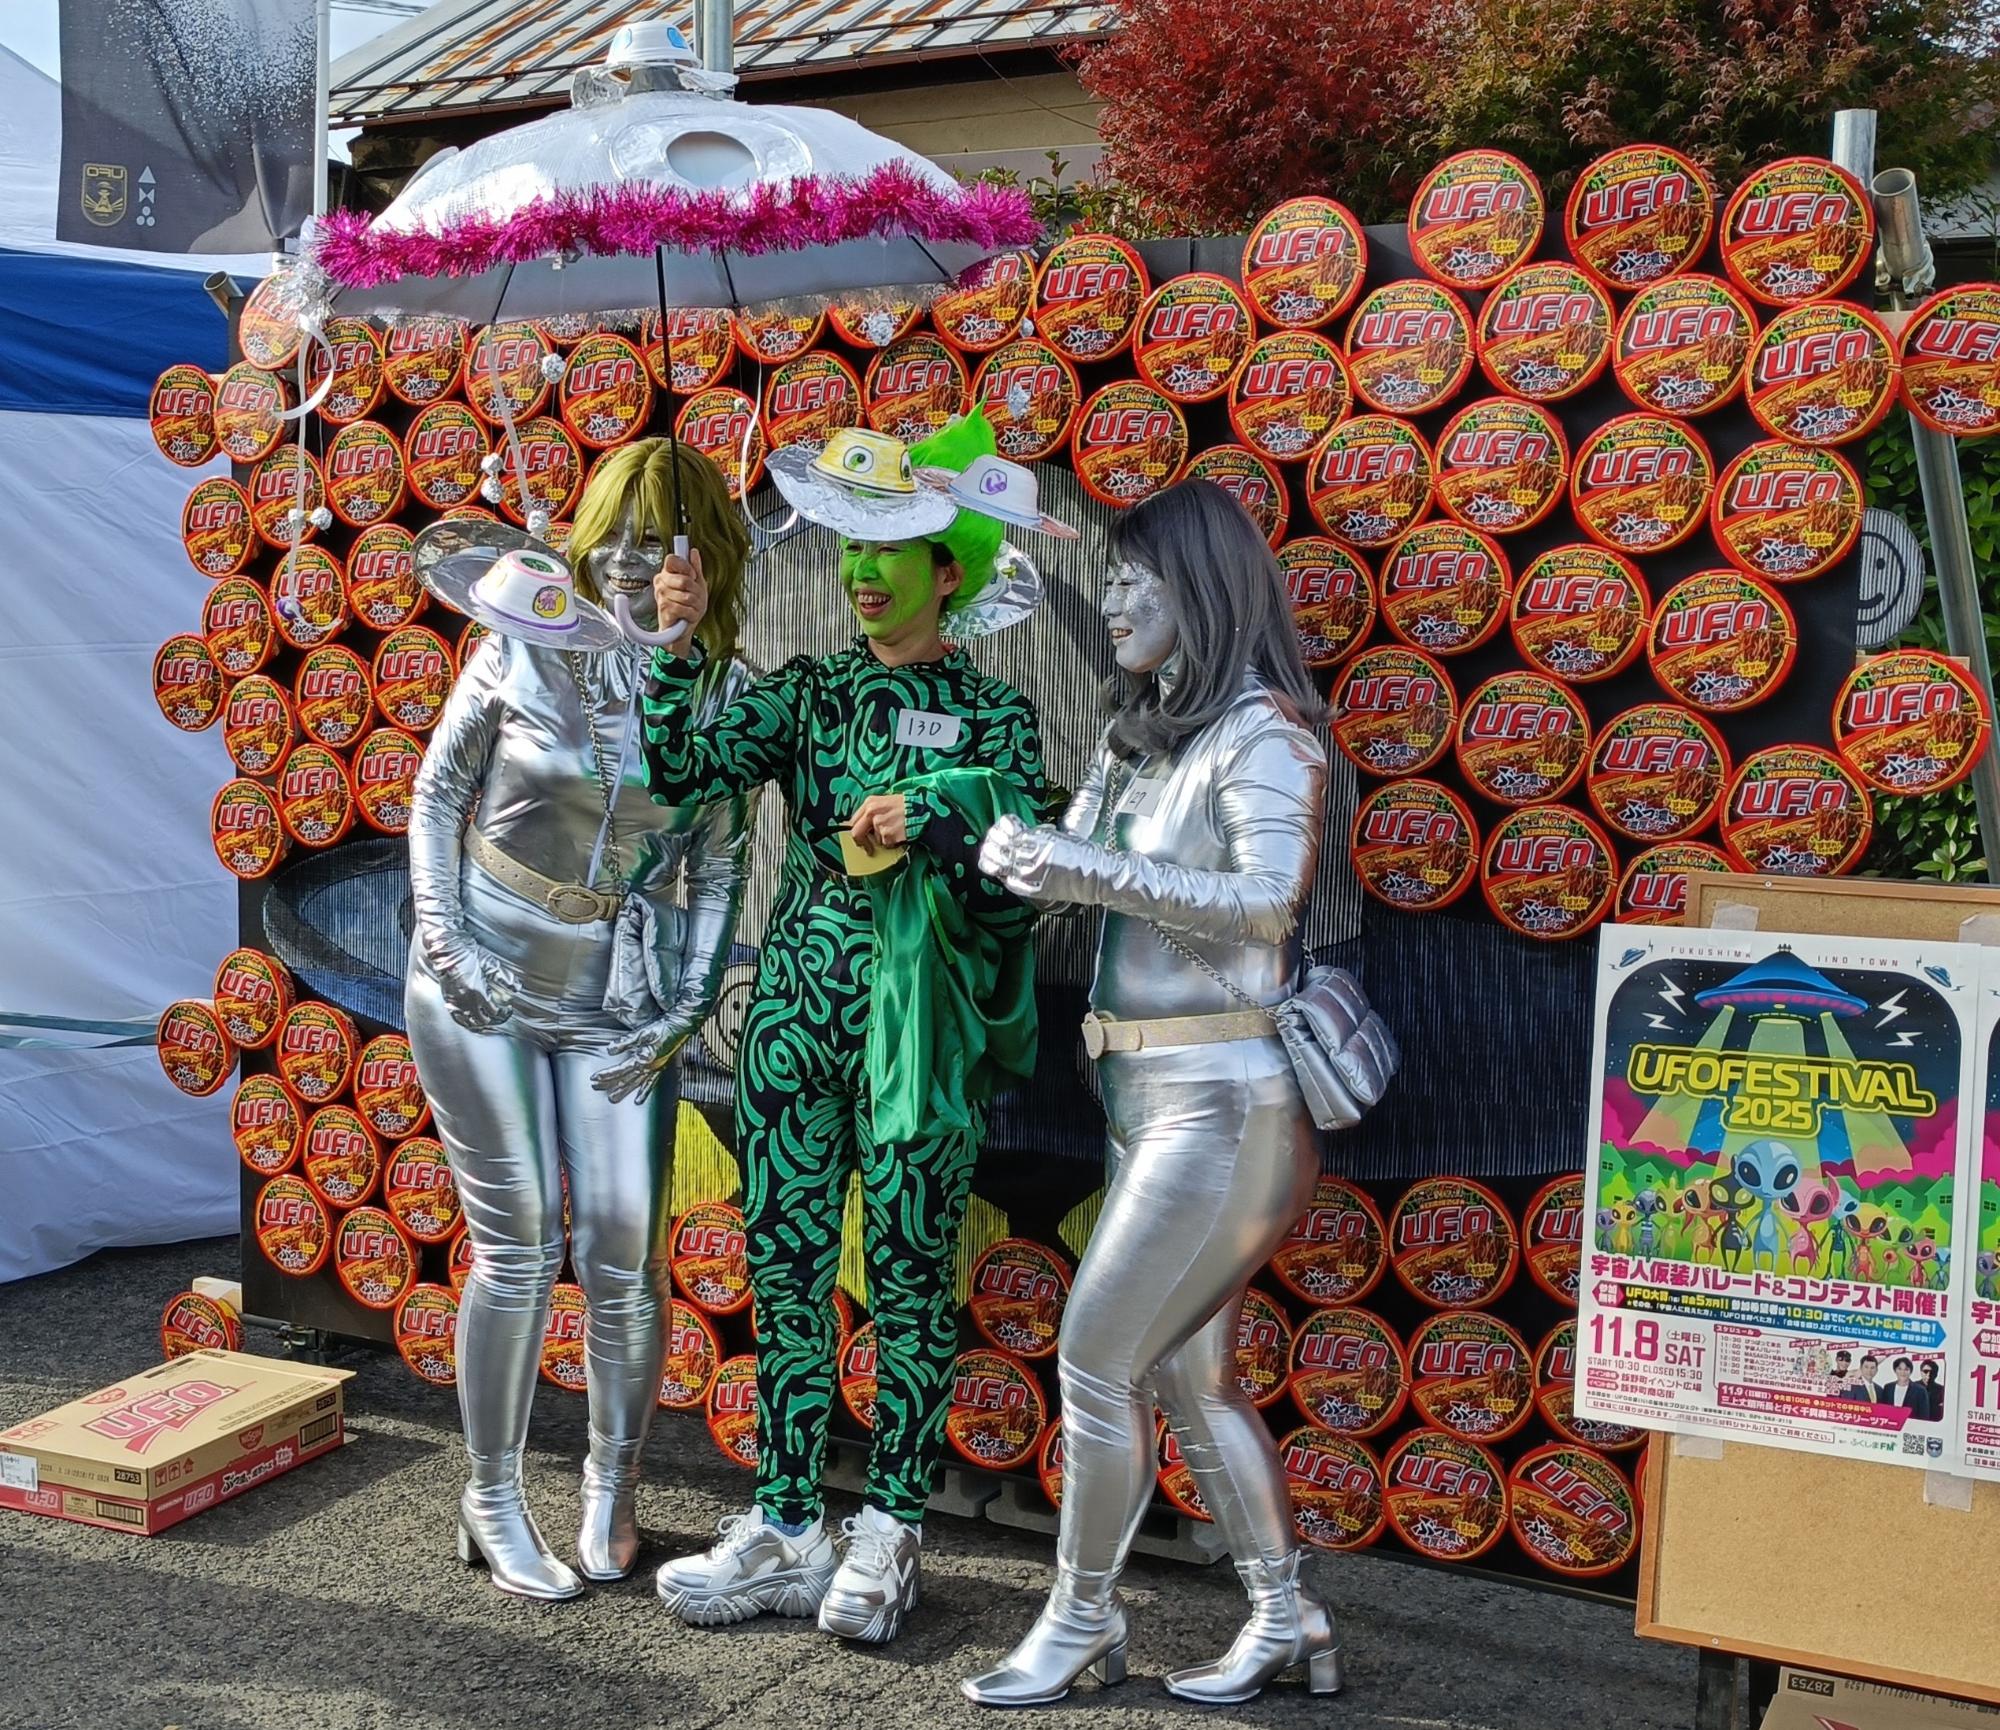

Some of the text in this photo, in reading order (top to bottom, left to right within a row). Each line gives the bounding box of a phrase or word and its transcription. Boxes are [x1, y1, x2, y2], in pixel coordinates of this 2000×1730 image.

[1817, 955, 1900, 968] IINO TOWN
[1635, 1052, 1928, 1109] UFOFESTIVAL
[1729, 1095, 1812, 1130] 2025
[1590, 1313, 1660, 1362] 11.8
[1664, 1343, 1706, 1368] SAT
[1587, 1356, 1703, 1380] START 10:30 CLOSED 15:30
[1722, 1385, 1744, 1397] 11.9
[1967, 1410, 1997, 1423] START
[115, 1470, 140, 1484] 28753
[1791, 1675, 1833, 1695] 28753
